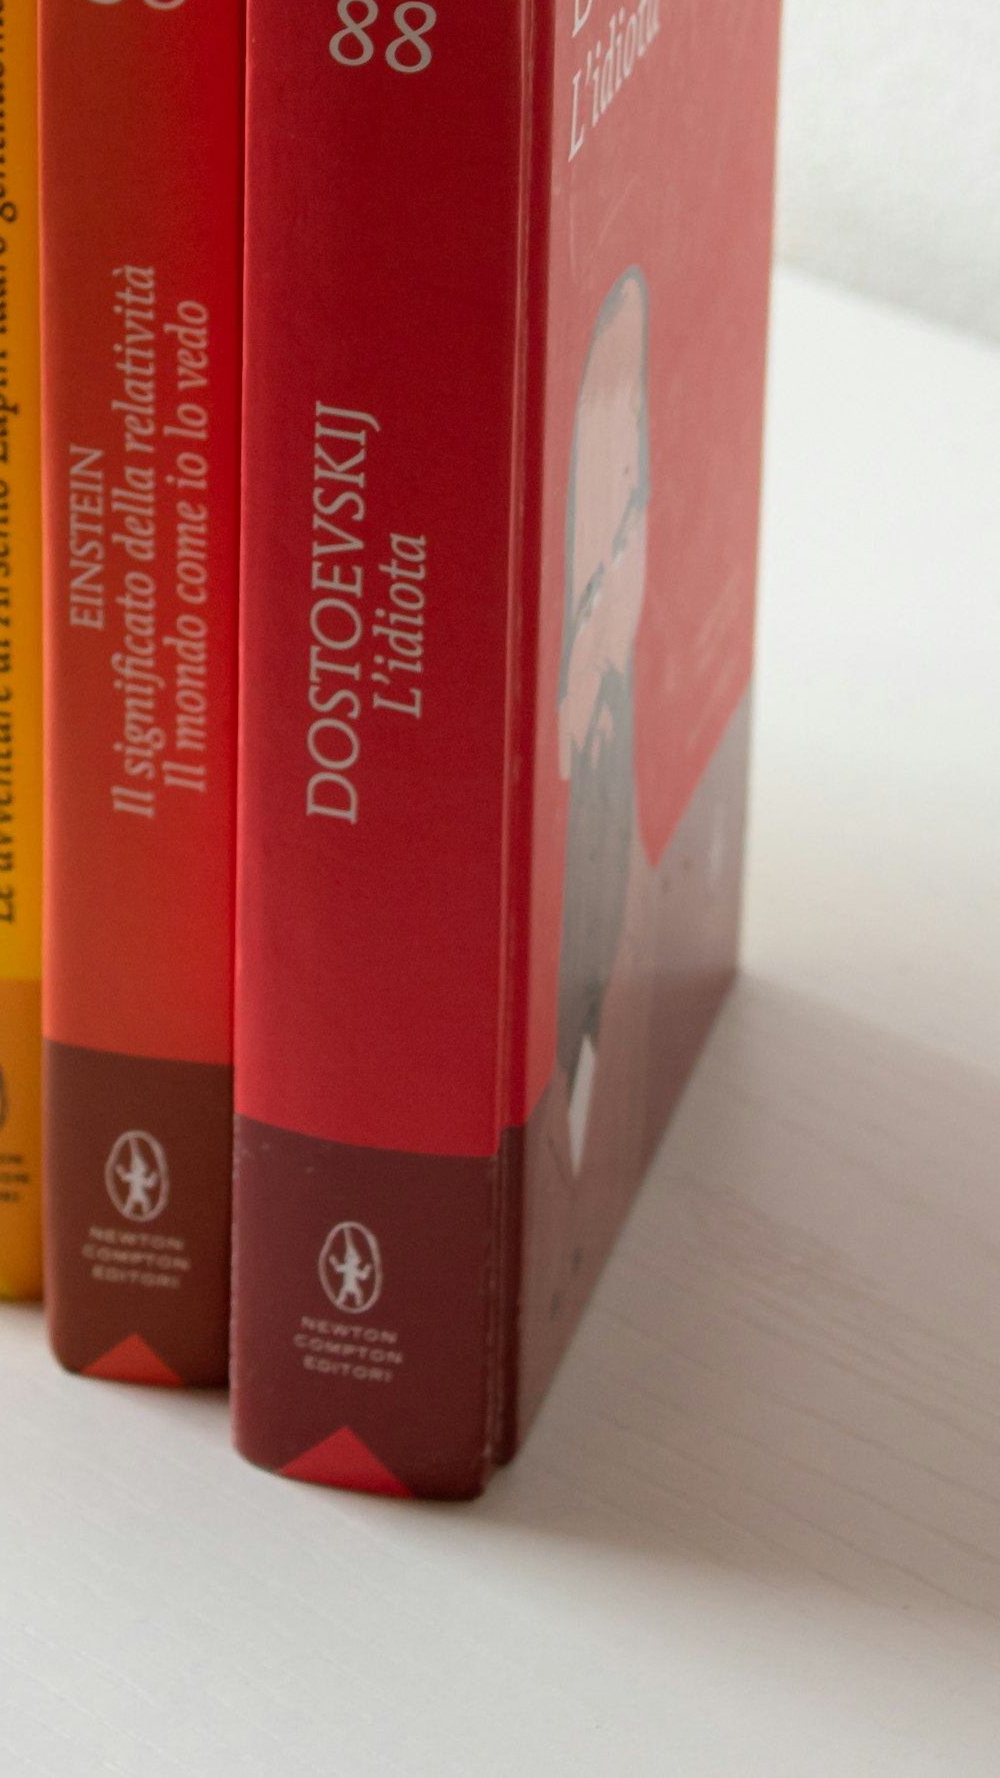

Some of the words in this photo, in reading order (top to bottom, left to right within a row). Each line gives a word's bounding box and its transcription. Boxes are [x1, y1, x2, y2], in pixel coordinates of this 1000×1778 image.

[111, 264, 155, 453] relatività
[163, 300, 209, 391] vedo
[163, 403, 209, 440] lo
[165, 452, 209, 491] io
[111, 466, 156, 562] della
[69, 442, 105, 631] EINSTEIN
[176, 501, 209, 605] come
[305, 400, 380, 824] DOSTOEVSKIJ
[373, 532, 427, 719] L'idiota
[111, 572, 166, 780] significato
[162, 614, 208, 751] mondo
[162, 761, 207, 793] Il
[110, 785, 156, 820] Il
[88, 1224, 185, 1251] NEWTON
[81, 1243, 191, 1273] COMPTON
[91, 1264, 181, 1289] EDITORI
[293, 1333, 403, 1364] COMPTON
[301, 1315, 398, 1344] NEWTON
[303, 1355, 393, 1383] EDITORI
